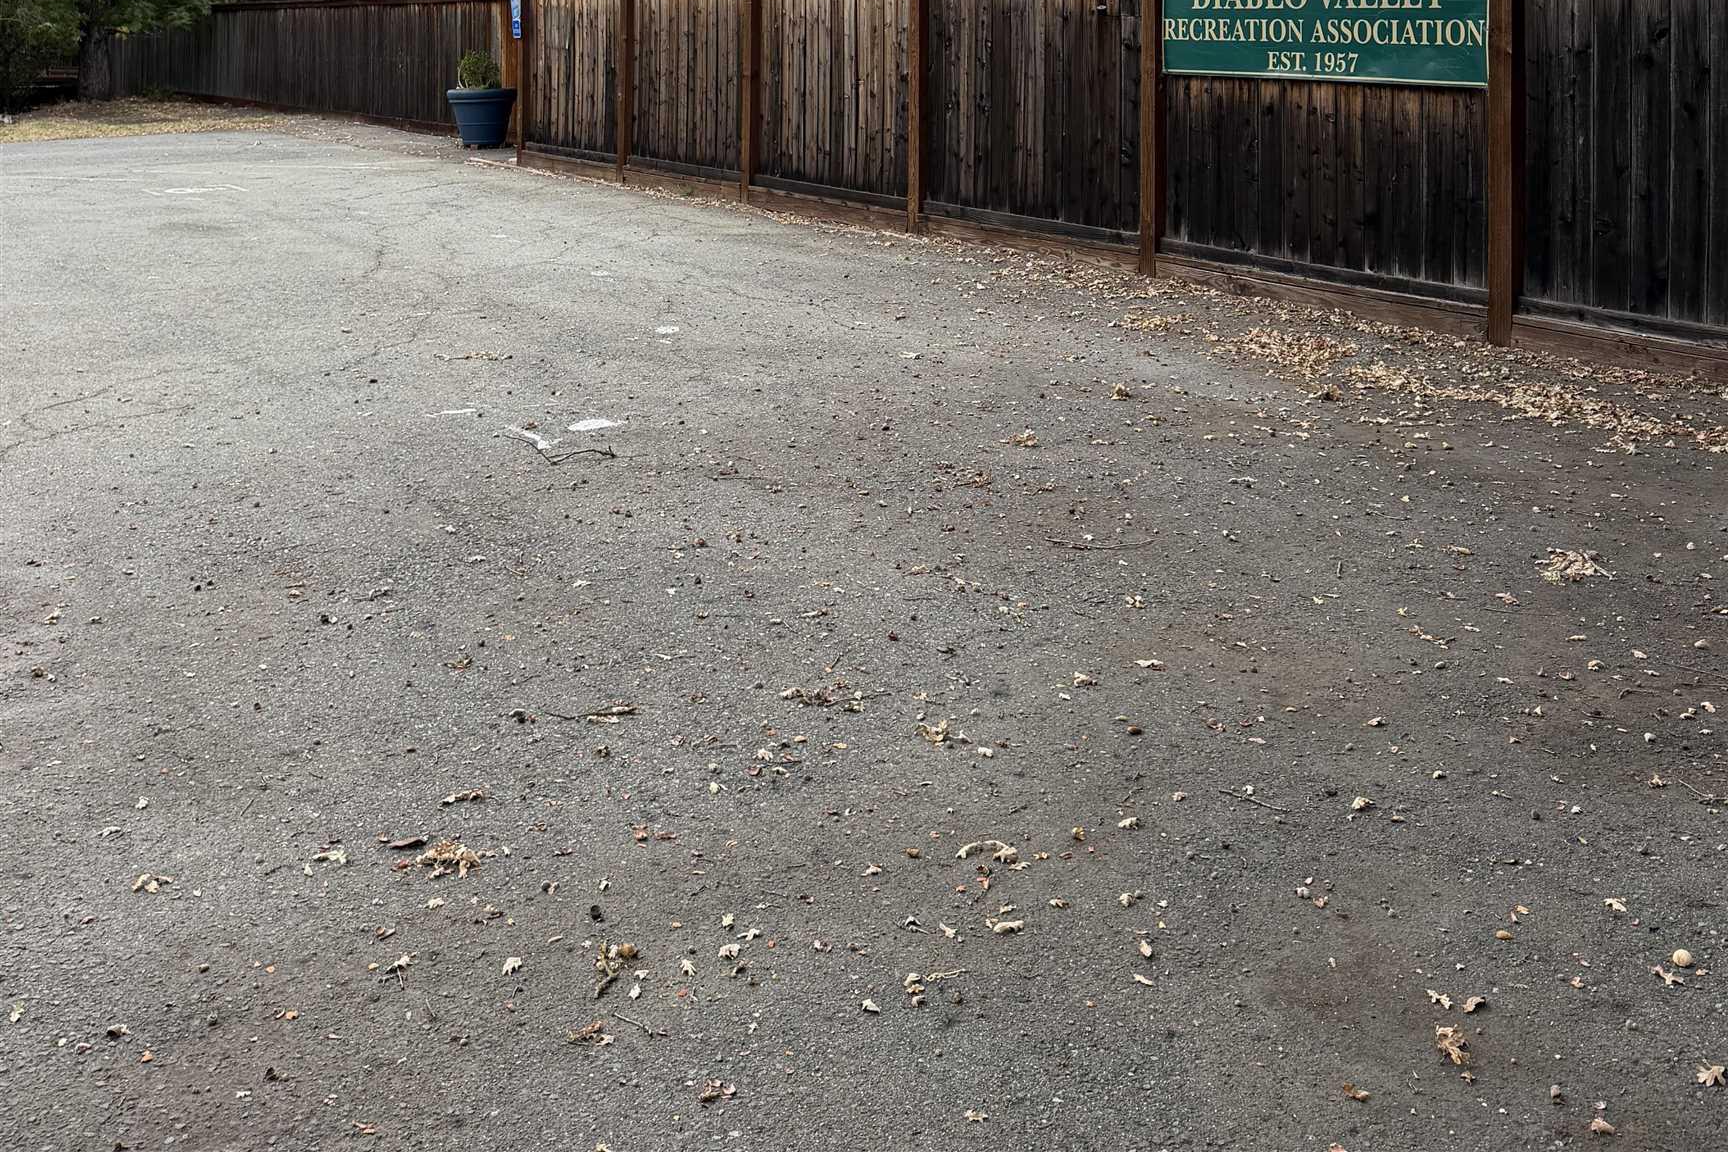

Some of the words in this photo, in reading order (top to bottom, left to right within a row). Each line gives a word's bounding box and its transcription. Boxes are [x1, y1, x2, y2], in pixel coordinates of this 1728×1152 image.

[1163, 18, 1304, 43] RECREATION
[1310, 19, 1486, 46] ASSOCIATION
[1267, 51, 1307, 73] EST.
[1314, 51, 1359, 74] 1957
